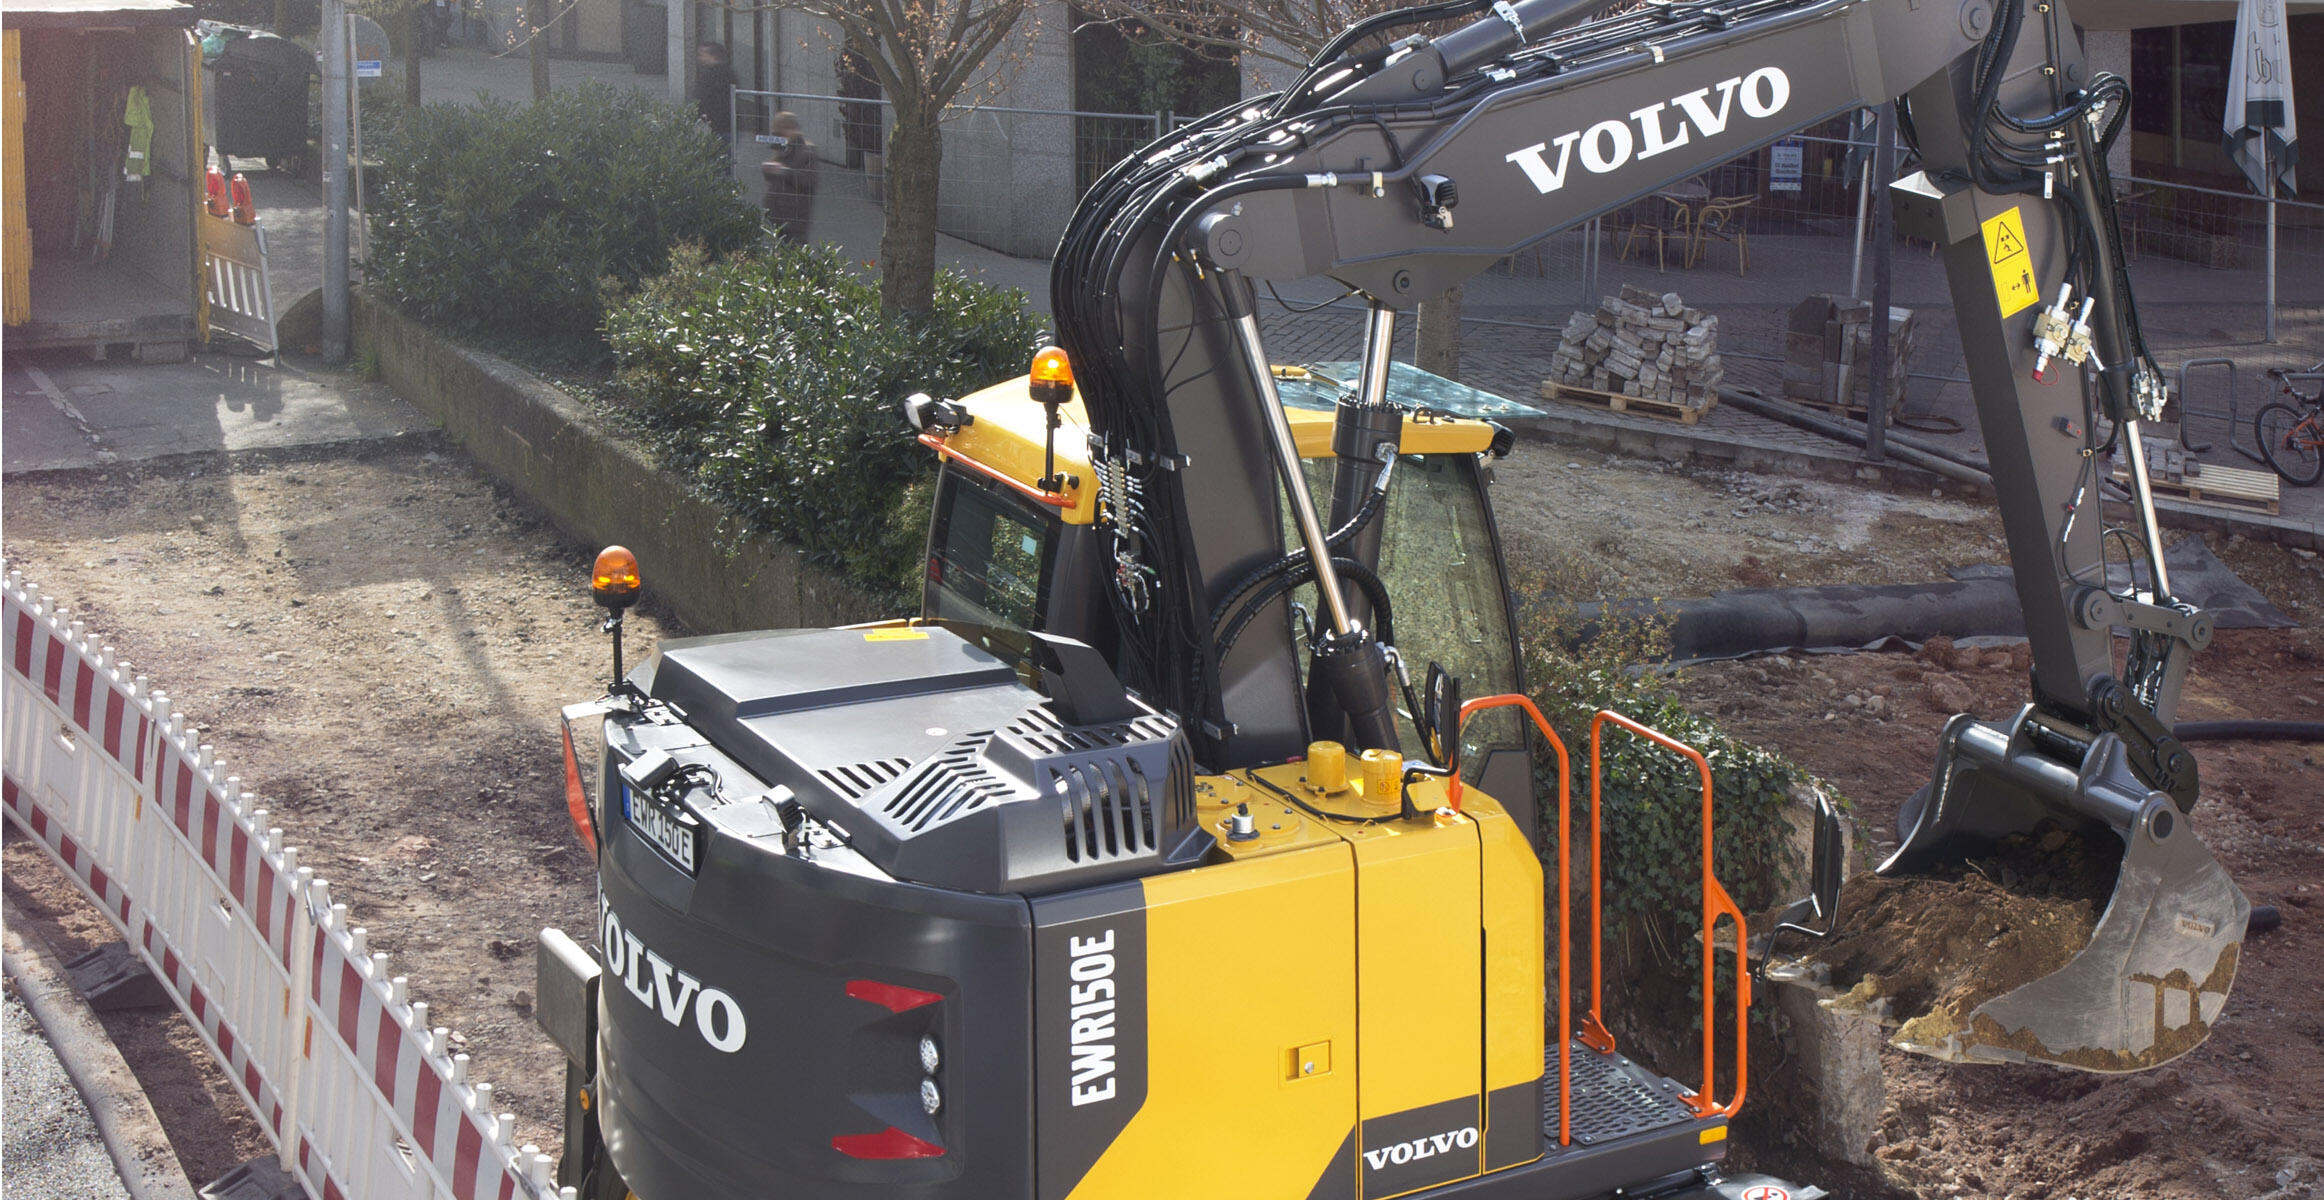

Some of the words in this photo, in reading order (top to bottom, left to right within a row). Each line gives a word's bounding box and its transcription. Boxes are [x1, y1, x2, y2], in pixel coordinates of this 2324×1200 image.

[1505, 66, 1790, 194] VOLVO
[634, 794, 657, 837] EWR
[658, 815, 691, 865] 150E
[1070, 929, 1116, 1107] EWR150E
[1362, 1127, 1479, 1171] VOLVO
